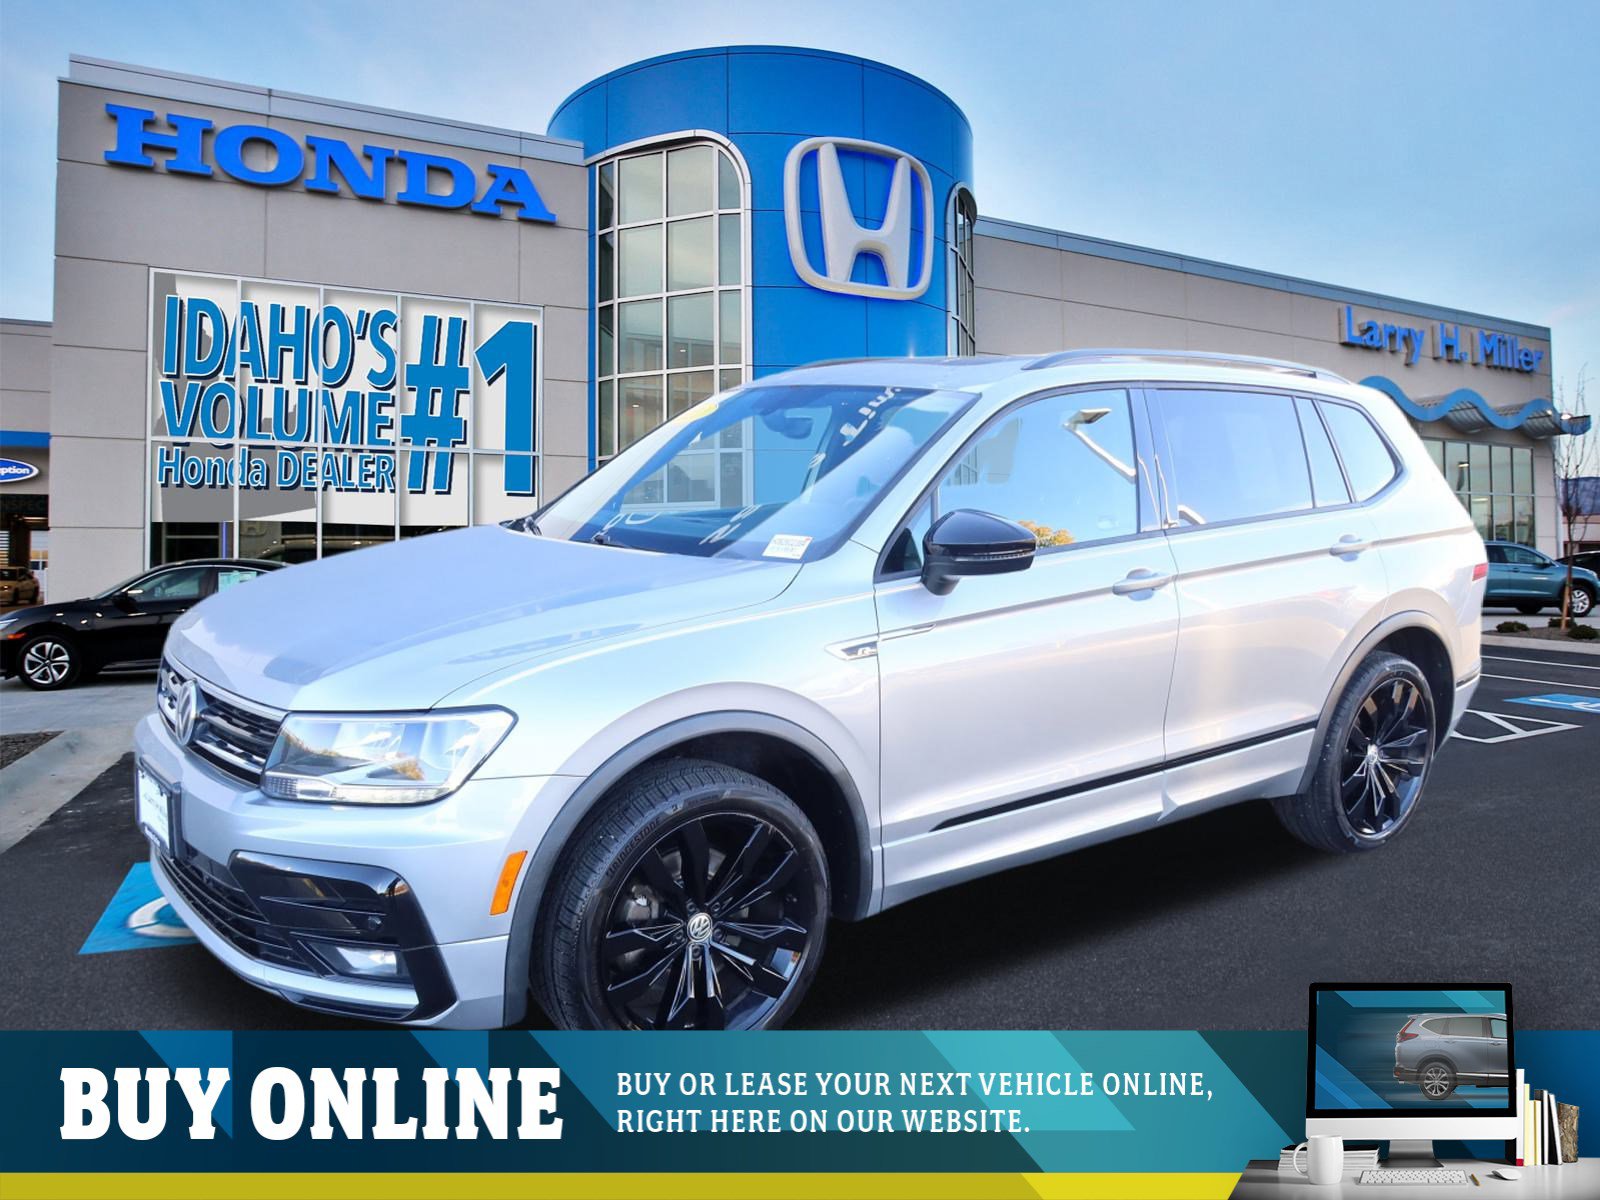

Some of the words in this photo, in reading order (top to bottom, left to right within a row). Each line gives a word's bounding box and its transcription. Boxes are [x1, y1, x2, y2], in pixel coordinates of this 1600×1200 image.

[104, 103, 557, 223] HONDA
[162, 294, 399, 389] IDAHO'S
[1343, 305, 1425, 366] Larry
[1437, 322, 1468, 361] H.
[1477, 329, 1544, 372] Miller
[159, 379, 395, 452] VOLUME
[400, 314, 538, 497] #1
[0, 465, 30, 476] ption
[156, 446, 269, 490] Honda
[276, 450, 397, 492] DEALER
